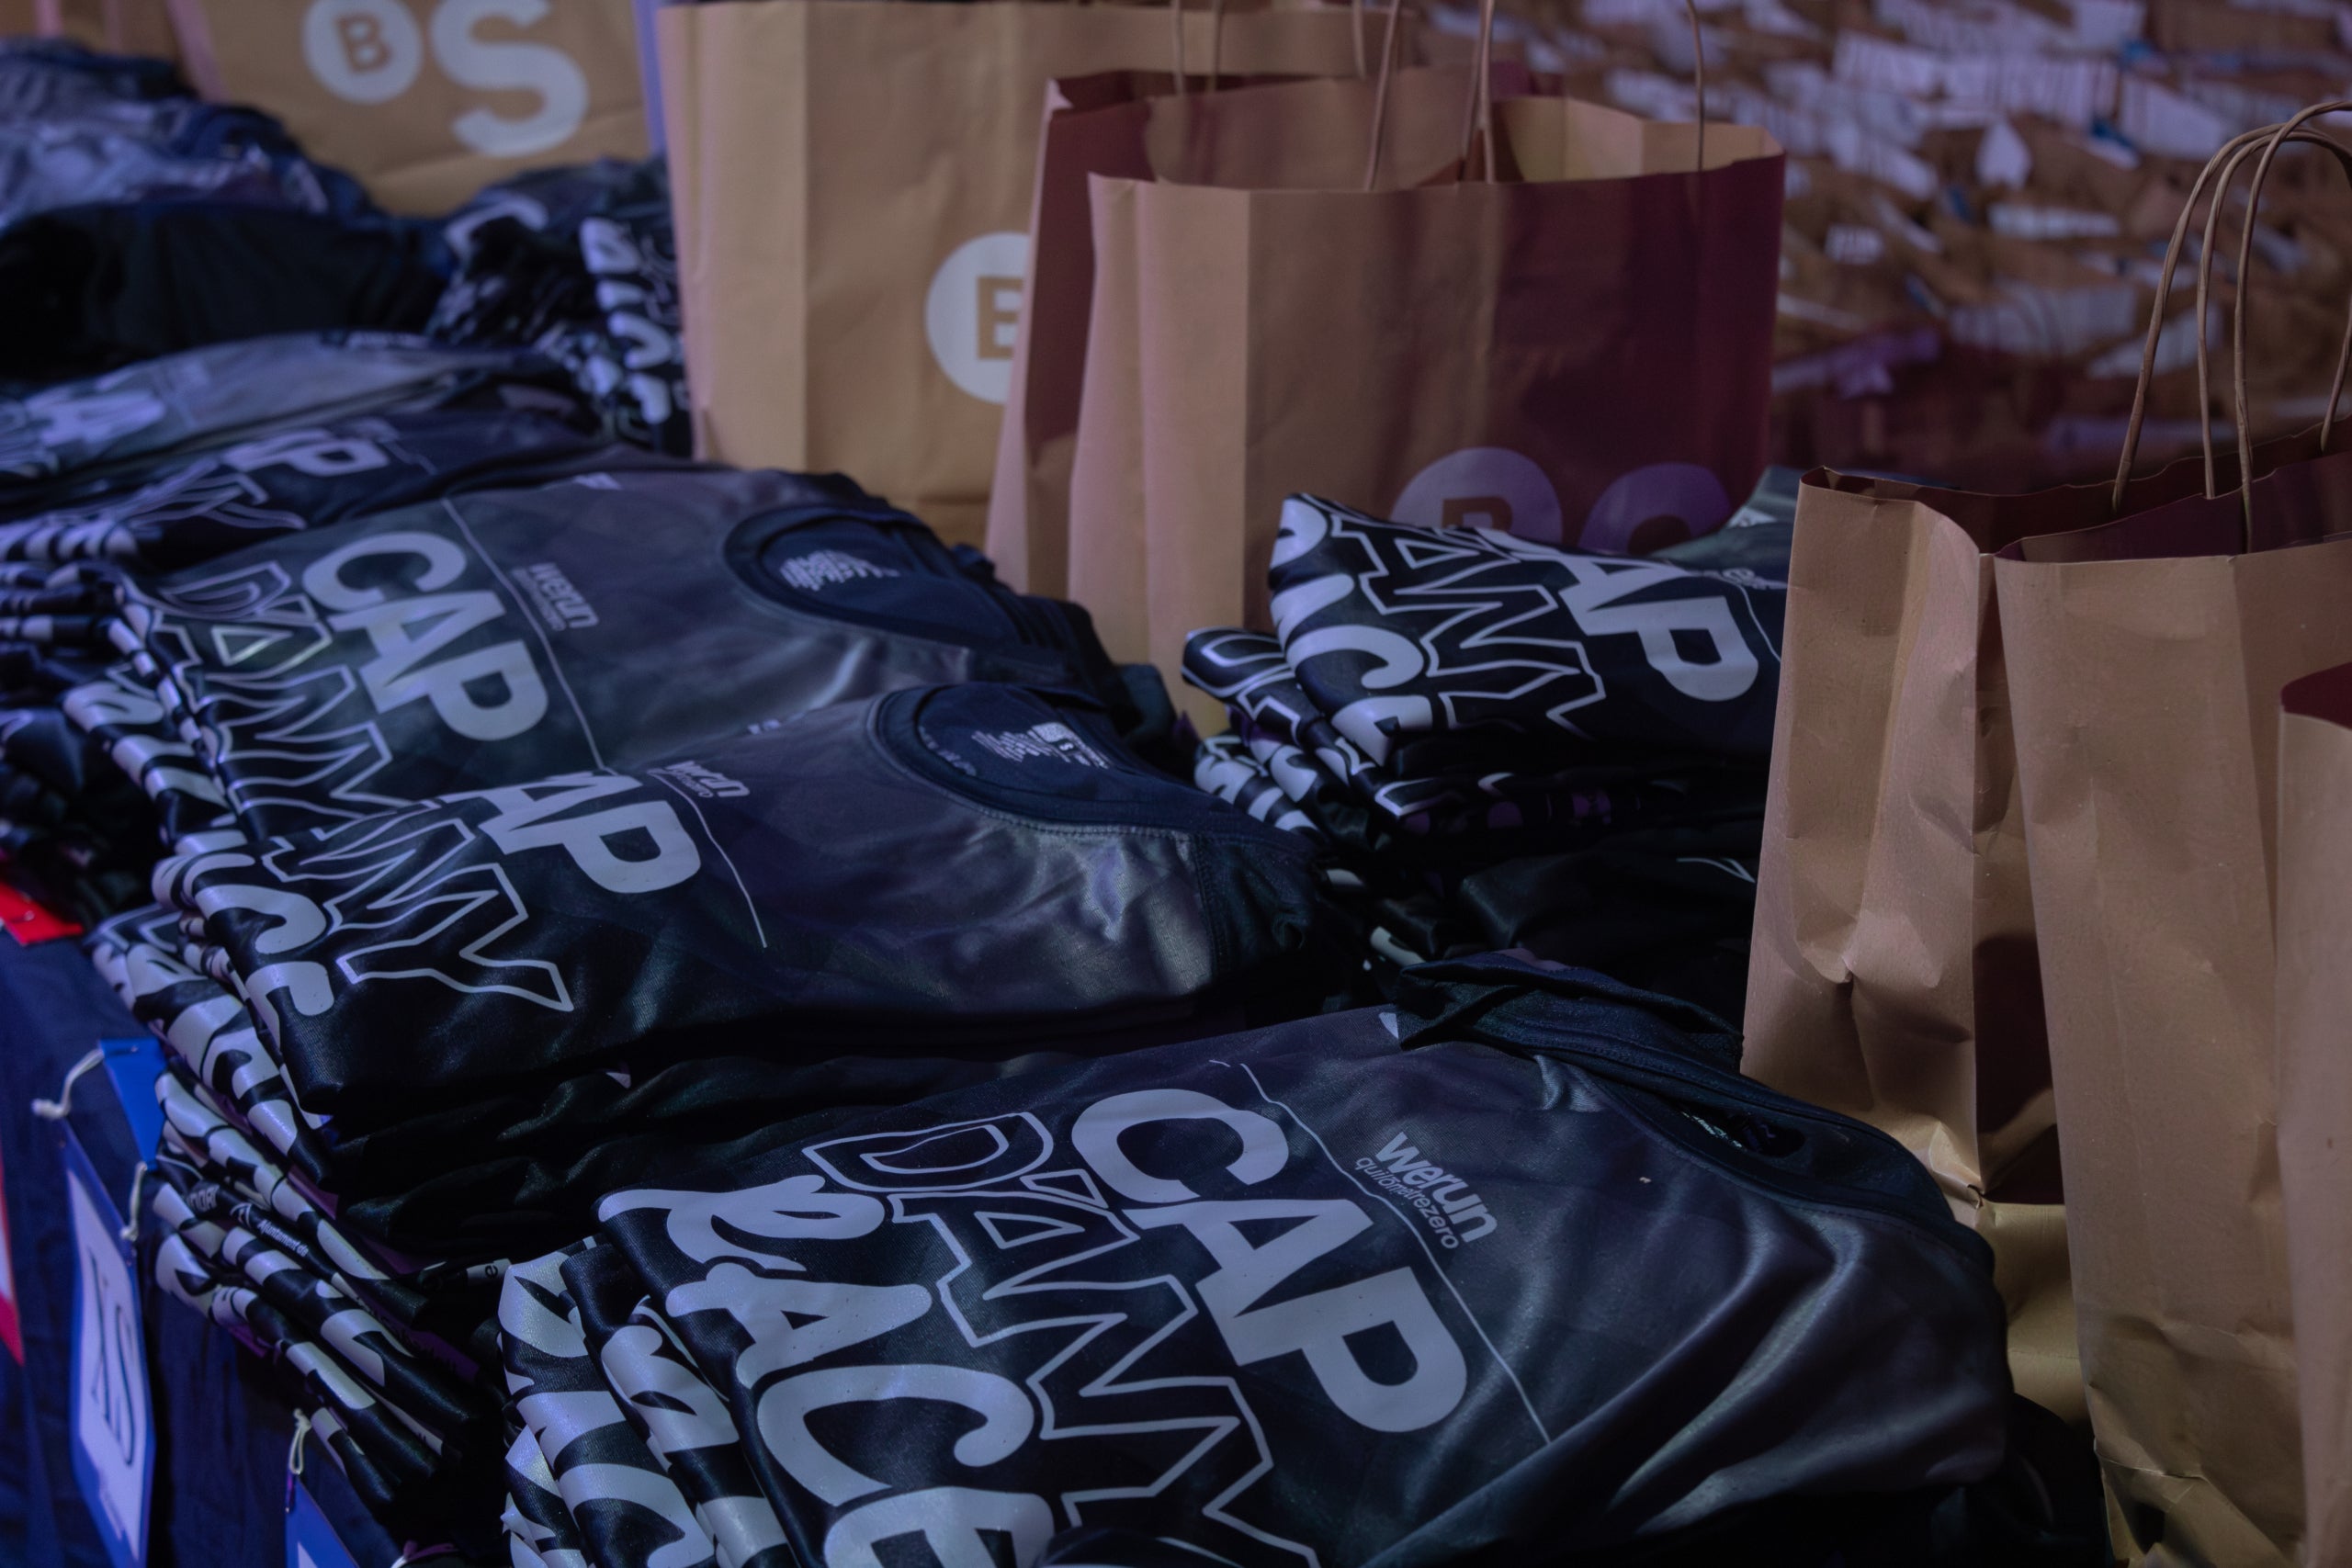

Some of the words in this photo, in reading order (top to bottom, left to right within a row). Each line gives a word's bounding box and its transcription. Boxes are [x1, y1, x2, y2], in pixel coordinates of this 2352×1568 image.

[301, 530, 548, 741] CAP
[1072, 1089, 1468, 1434] CAP
[1375, 1131, 1498, 1243] werun
